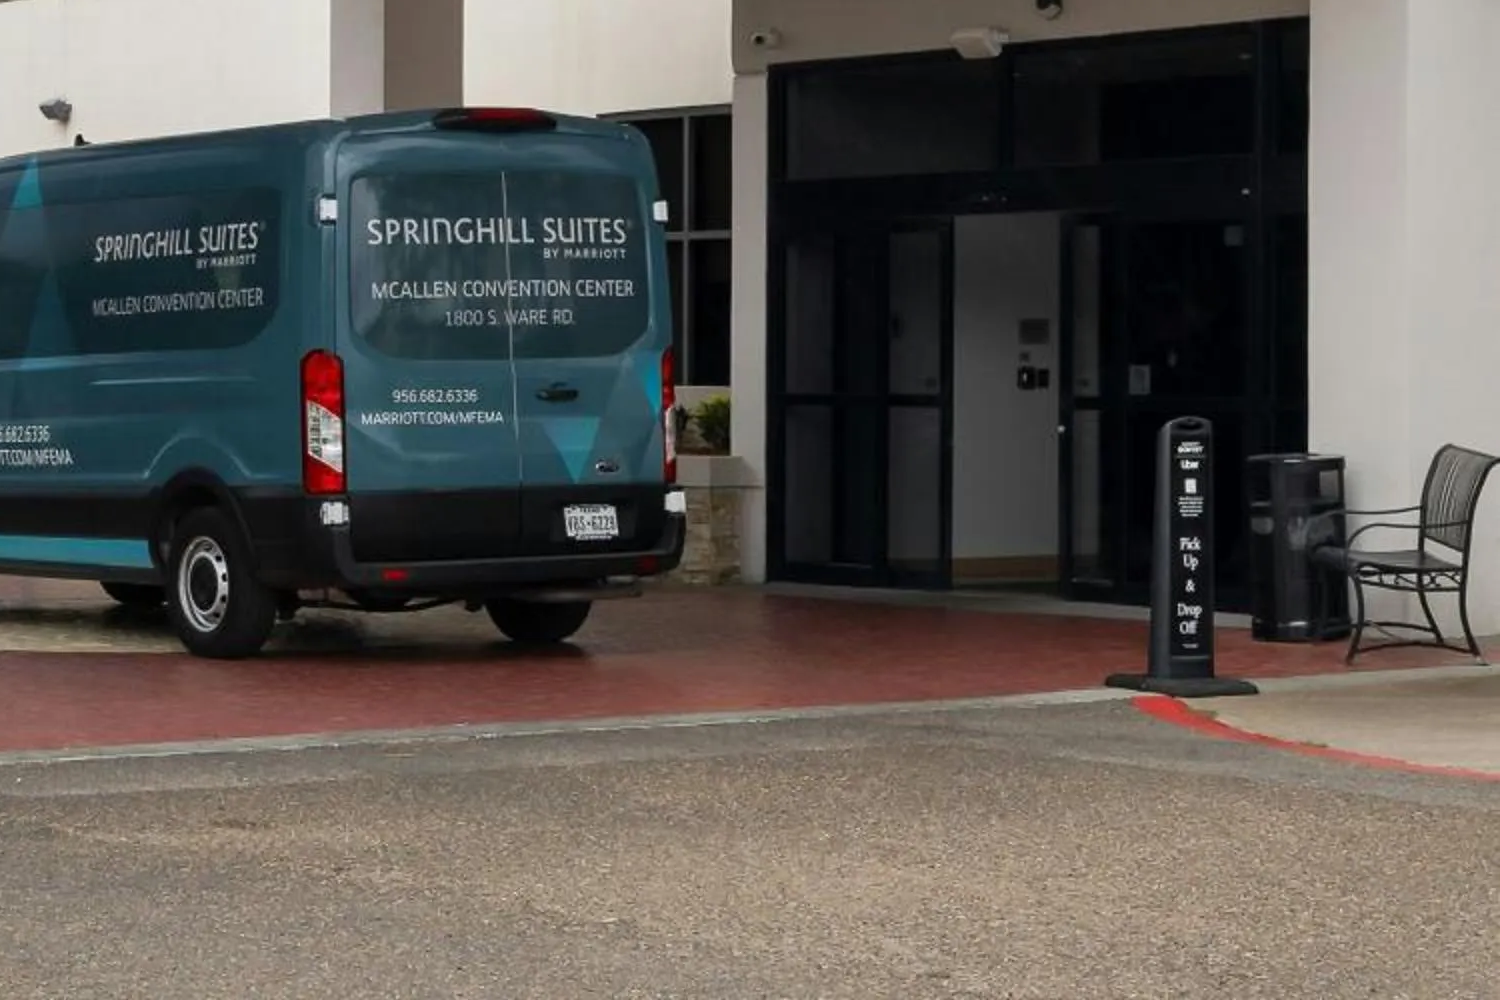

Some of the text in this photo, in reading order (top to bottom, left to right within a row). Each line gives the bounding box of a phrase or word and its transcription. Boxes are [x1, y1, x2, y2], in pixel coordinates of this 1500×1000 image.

[367, 217, 627, 245] SPRINGHILL SUITES
[93, 222, 258, 263] SPRINGHILL SUITES
[196, 253, 257, 269] BY MARRIOTT
[543, 248, 626, 259] BY MARRIOTT
[371, 279, 635, 299] MCALLEN CONVENTION CENTER
[93, 287, 263, 316] MCALLEN CONVENTION CENTER
[446, 309, 575, 326] 1800 S. WARE RD.
[392, 388, 479, 403] 956.682.6336
[361, 411, 504, 425] MARRIOTT.COM/MFEMA
[1180, 537, 1201, 550] Pick
[1183, 553, 1199, 571] Up
[1185, 579, 1196, 593] &
[1177, 603, 1202, 619] Drop
[1179, 620, 1198, 634] Off
